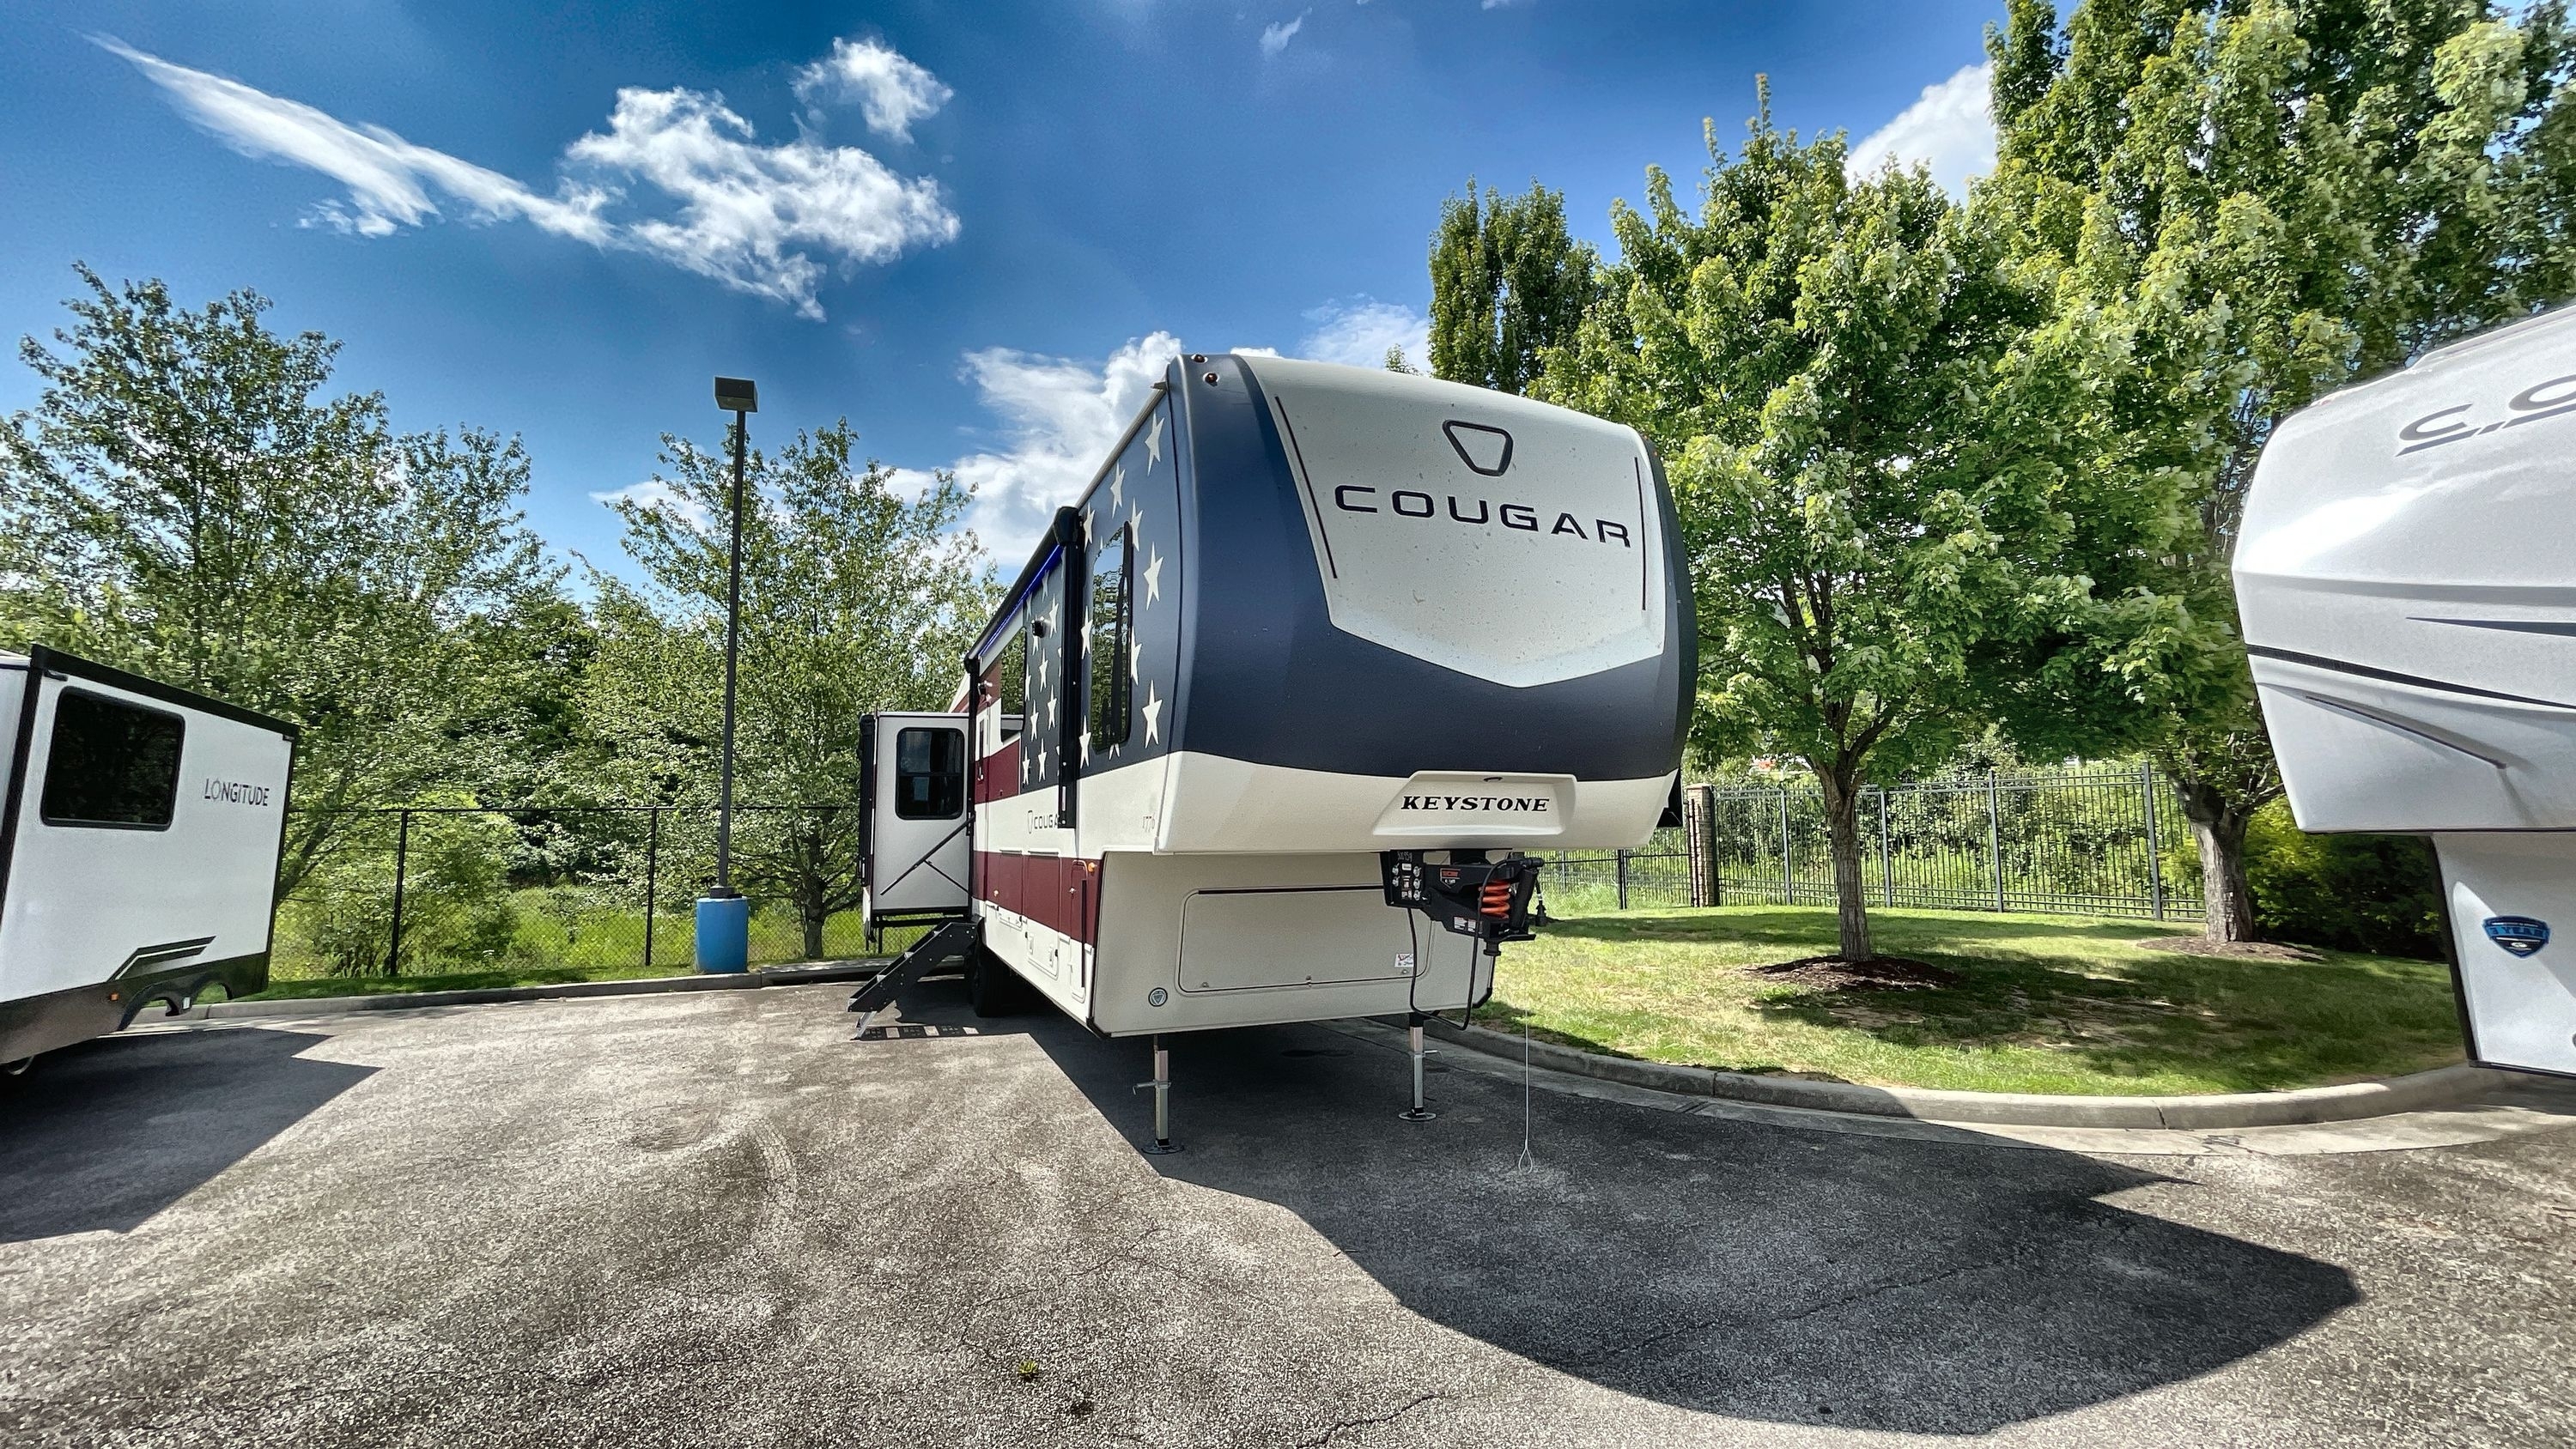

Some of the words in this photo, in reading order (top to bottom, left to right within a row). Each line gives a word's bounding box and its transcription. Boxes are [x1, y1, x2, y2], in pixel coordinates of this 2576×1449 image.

[1334, 484, 1631, 549] COUGAR
[204, 778, 270, 806] LONGITUDE
[1400, 796, 1550, 812] KEYSTONE
[1034, 814, 1060, 829] COUGA
